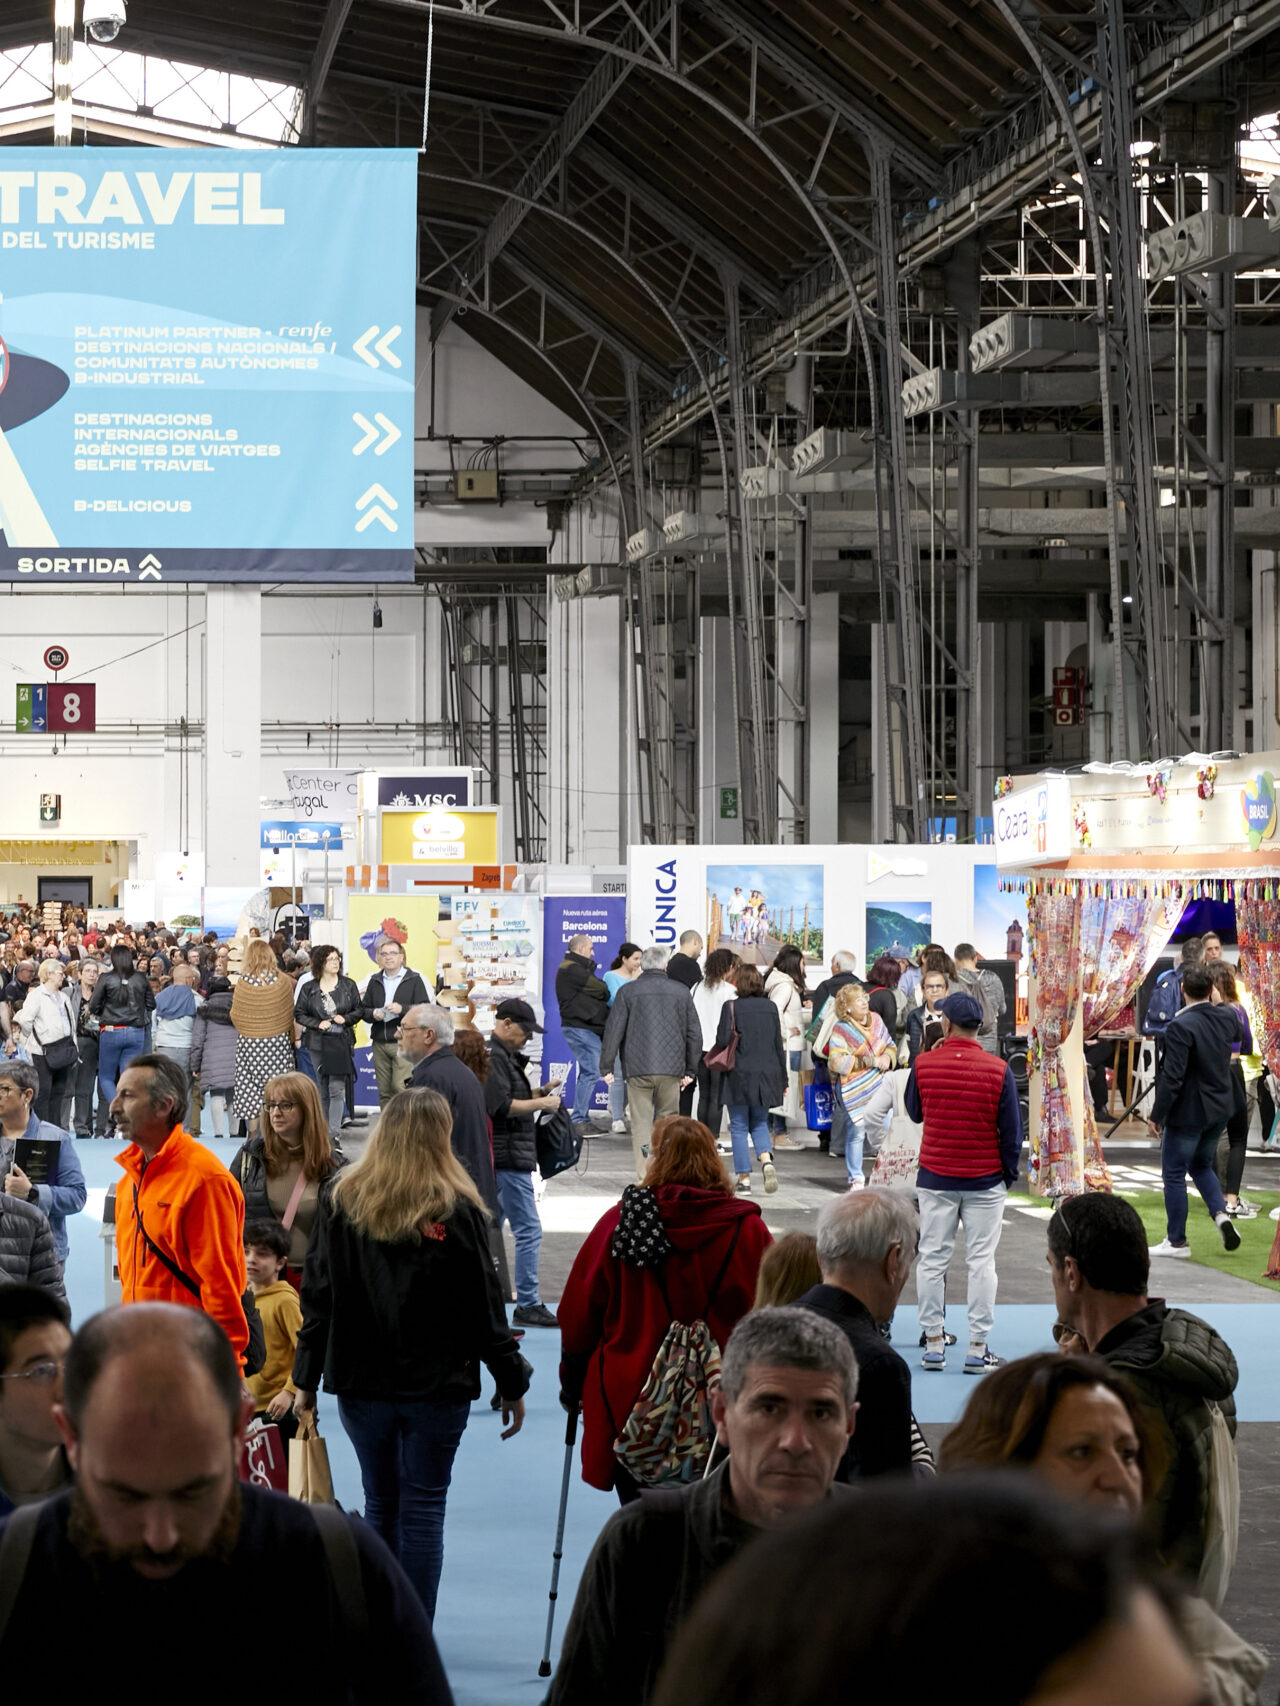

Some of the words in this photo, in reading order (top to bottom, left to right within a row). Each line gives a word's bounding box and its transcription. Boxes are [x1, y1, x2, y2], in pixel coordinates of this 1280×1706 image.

[2, 231, 47, 249] DEL
[53, 231, 155, 249] TURISME
[74, 326, 169, 339] PLATINUM
[173, 327, 261, 339] PARTNER
[278, 321, 332, 342] renfe
[74, 342, 213, 354] DESTINACIONS
[218, 342, 325, 354] NACIONALS
[74, 357, 196, 369] COMUNITATS
[74, 372, 205, 384] B-INDUSTRIAL
[74, 413, 213, 426] DESTINACIONS
[74, 429, 238, 441] INTERNACIONALS
[171, 444, 195, 456] DE
[201, 445, 281, 457] VIATGES
[74, 459, 136, 471] SELFIE
[141, 459, 215, 472] TRAVEL
[74, 500, 192, 512] B-DELICIOUS
[17, 557, 131, 574] SORTIDA
[36, 687, 43, 702] 1
[62, 692, 81, 723] 8
[292, 775, 342, 793] Center
[413, 793, 457, 807] MSC
[1248, 803, 1270, 820] BRASIL
[455, 901, 479, 912] FFV
[649, 859, 677, 948] ÚNICA
[562, 920, 608, 931] Barcelona
